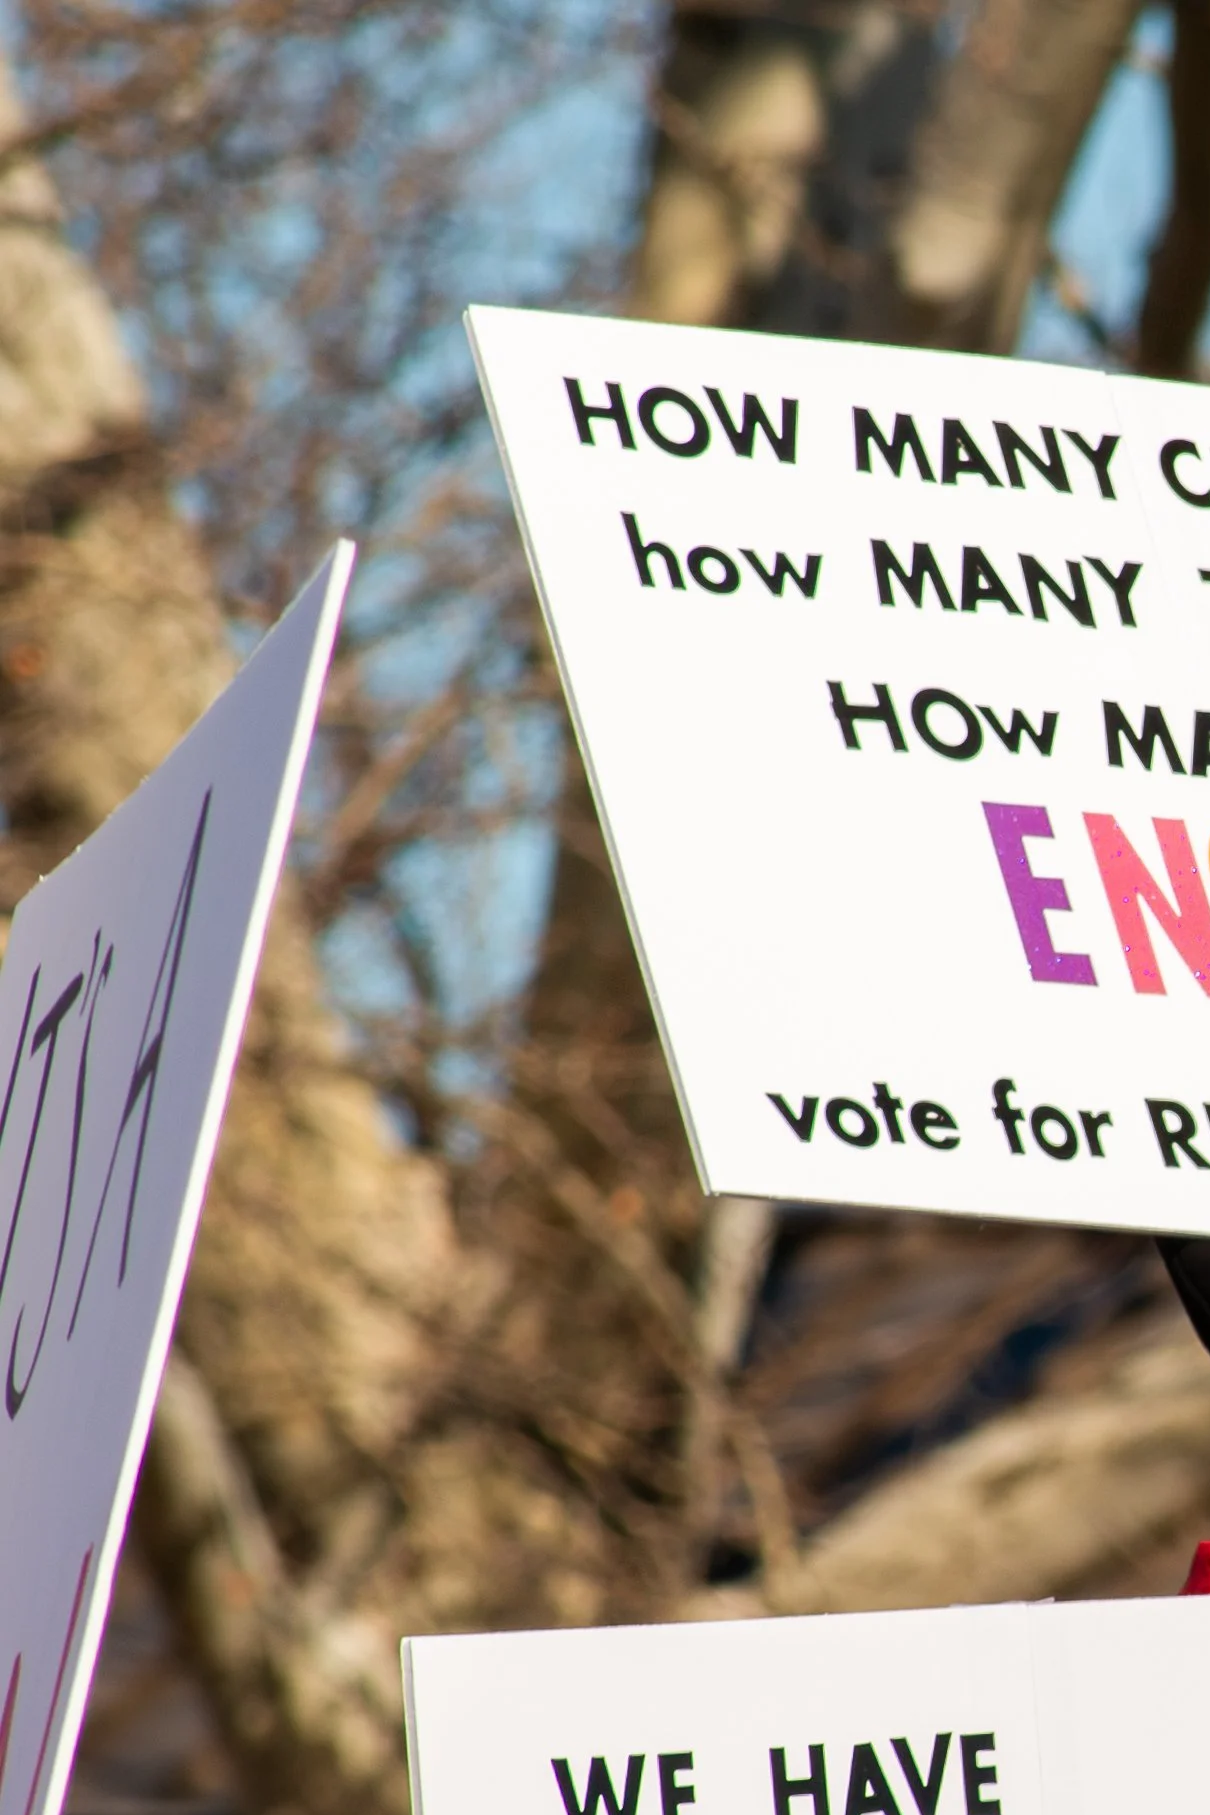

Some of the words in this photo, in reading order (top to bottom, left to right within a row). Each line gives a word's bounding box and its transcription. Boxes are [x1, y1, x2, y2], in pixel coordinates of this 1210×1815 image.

[565, 377, 799, 464] HOW
[853, 407, 1120, 500] MANY
[621, 513, 823, 598] how
[871, 539, 1142, 627] MANY
[827, 681, 1059, 760] HOw
[767, 1083, 962, 1150] vote
[993, 1078, 1112, 1161] for
